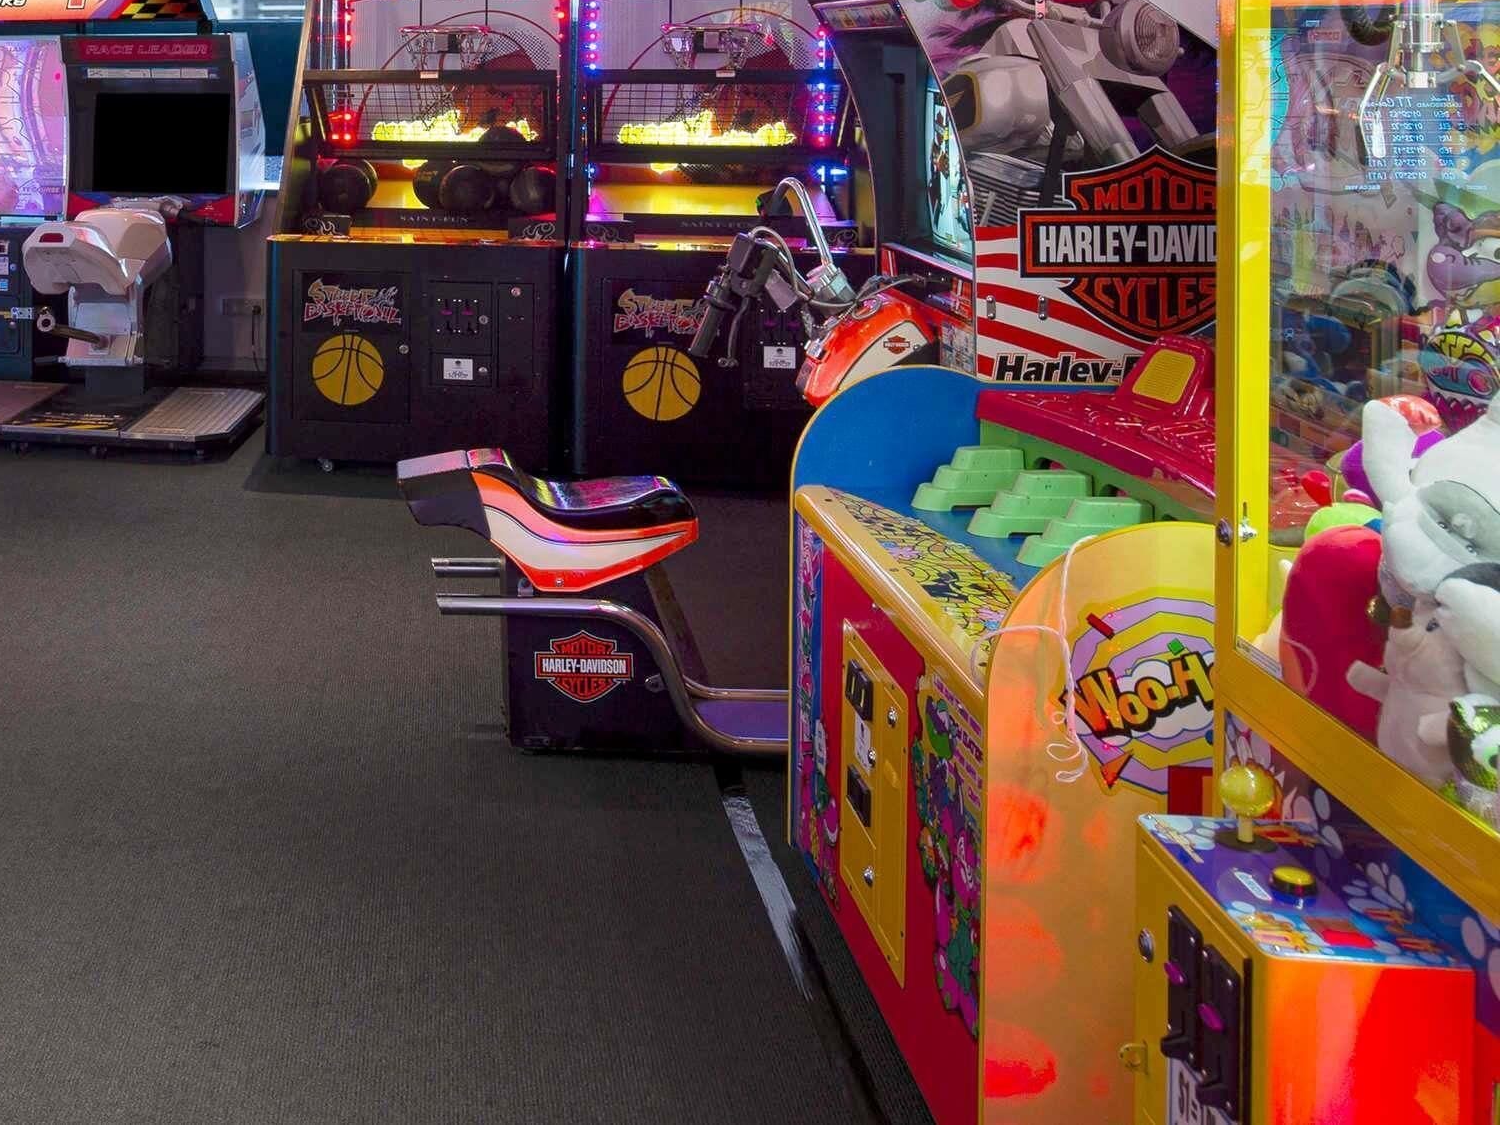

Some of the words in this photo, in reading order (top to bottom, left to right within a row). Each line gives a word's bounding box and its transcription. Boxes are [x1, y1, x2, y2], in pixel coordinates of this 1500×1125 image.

[85, 44, 134, 55] RACE
[137, 43, 208, 55] LEADER
[1094, 167, 1217, 211] MOTOR
[1093, 277, 1216, 327] CYCLES
[542, 658, 627, 674] HARLEY-DAVIDSON
[1063, 651, 1214, 733] Woo-H
